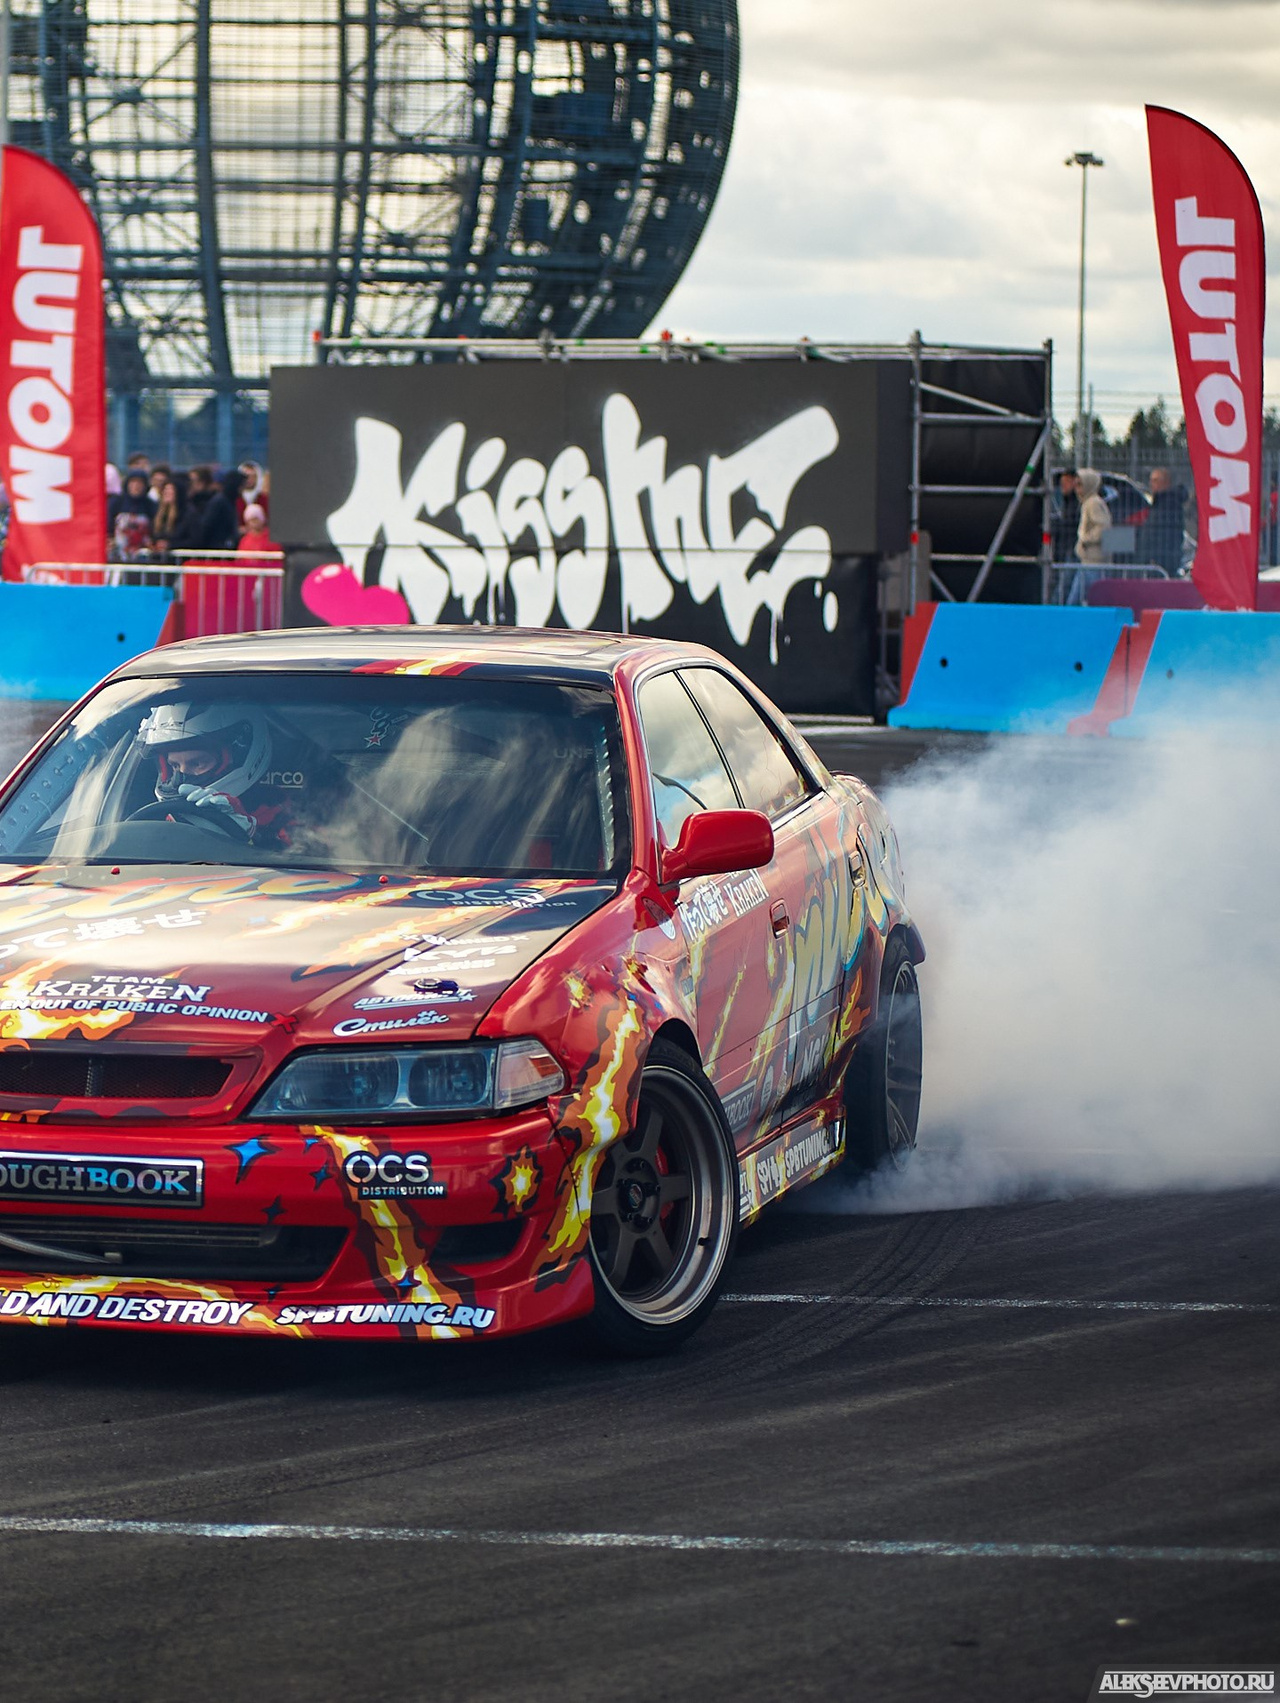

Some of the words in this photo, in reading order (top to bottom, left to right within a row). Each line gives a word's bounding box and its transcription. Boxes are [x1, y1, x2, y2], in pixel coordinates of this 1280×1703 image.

[415, 888, 545, 905] OCS
[29, 980, 212, 1002] KRAKEN
[91, 975, 166, 985] TEAM
[30, 999, 74, 1011] OUT
[72, 1000, 101, 1011] OF
[102, 1000, 178, 1015] PUBLIC
[181, 1004, 269, 1023] OPINION
[345, 1154, 430, 1183] OCS
[361, 1185, 444, 1196] DISTRIBUTION
[25, 1293, 103, 1317] AND
[98, 1298, 255, 1325] DESTROY
[275, 1305, 495, 1328] SPBTUNING.RU
